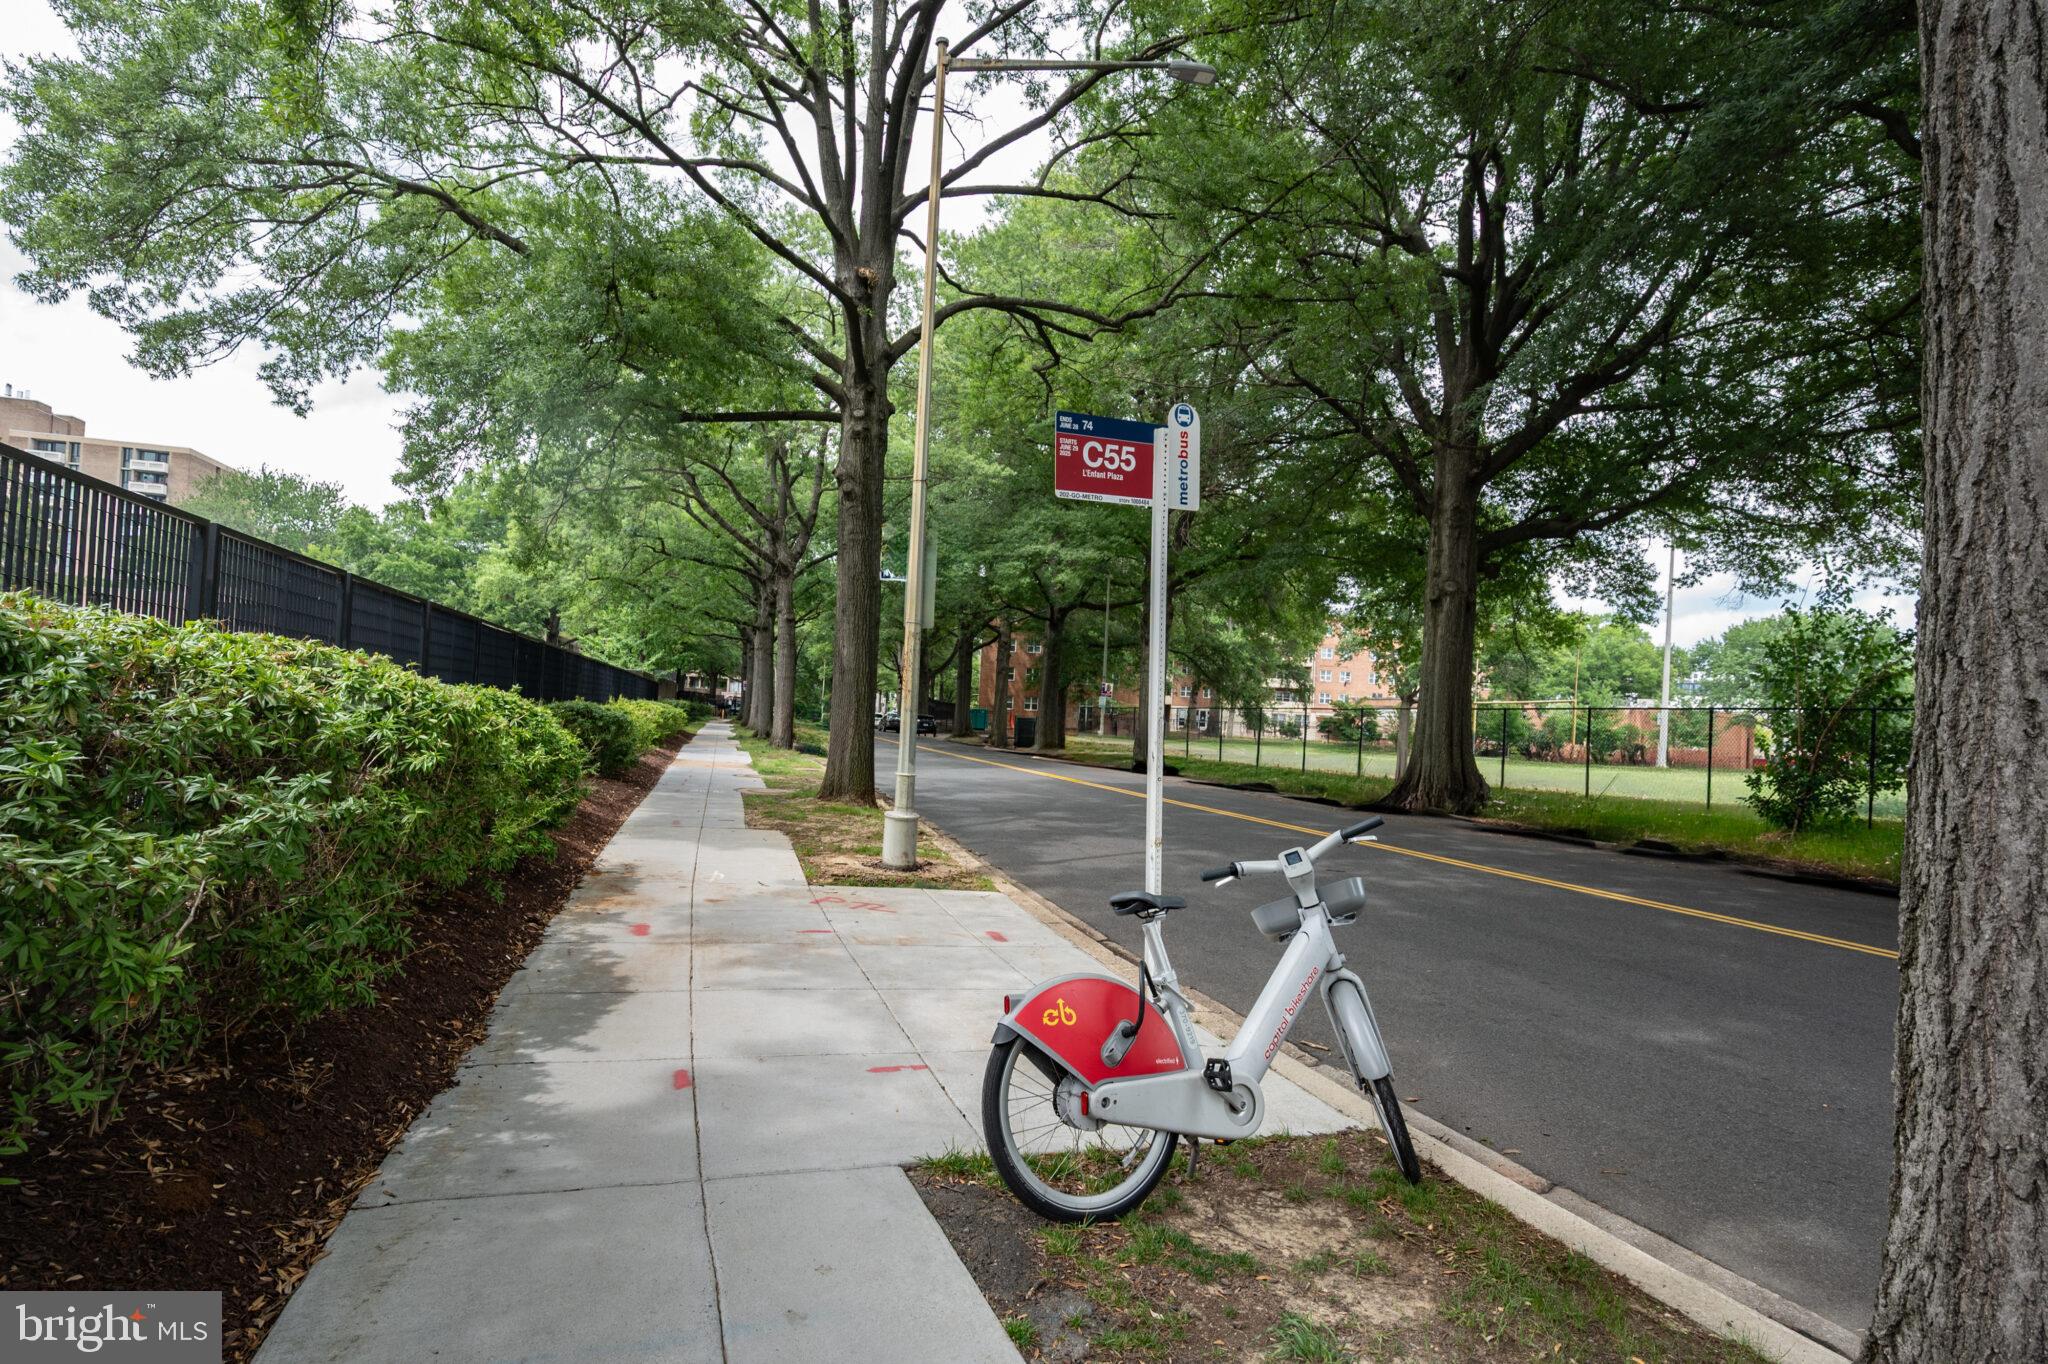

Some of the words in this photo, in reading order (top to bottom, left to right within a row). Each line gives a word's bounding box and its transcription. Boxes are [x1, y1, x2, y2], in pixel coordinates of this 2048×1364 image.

[1059, 415, 1072, 423] ENDS
[1060, 422, 1072, 430] JUNE
[1082, 420, 1093, 431] 74
[1060, 443, 1071, 452] JUNE
[1082, 441, 1136, 472] C55
[1178, 431, 1189, 505] metrobus
[1082, 469, 1106, 479] L'Enfant
[1107, 472, 1124, 481] Plaza
[1059, 491, 1104, 501] 202-GO-METRO
[1263, 1016, 1289, 1060] capital
[1285, 966, 1319, 1017] bikeshare
